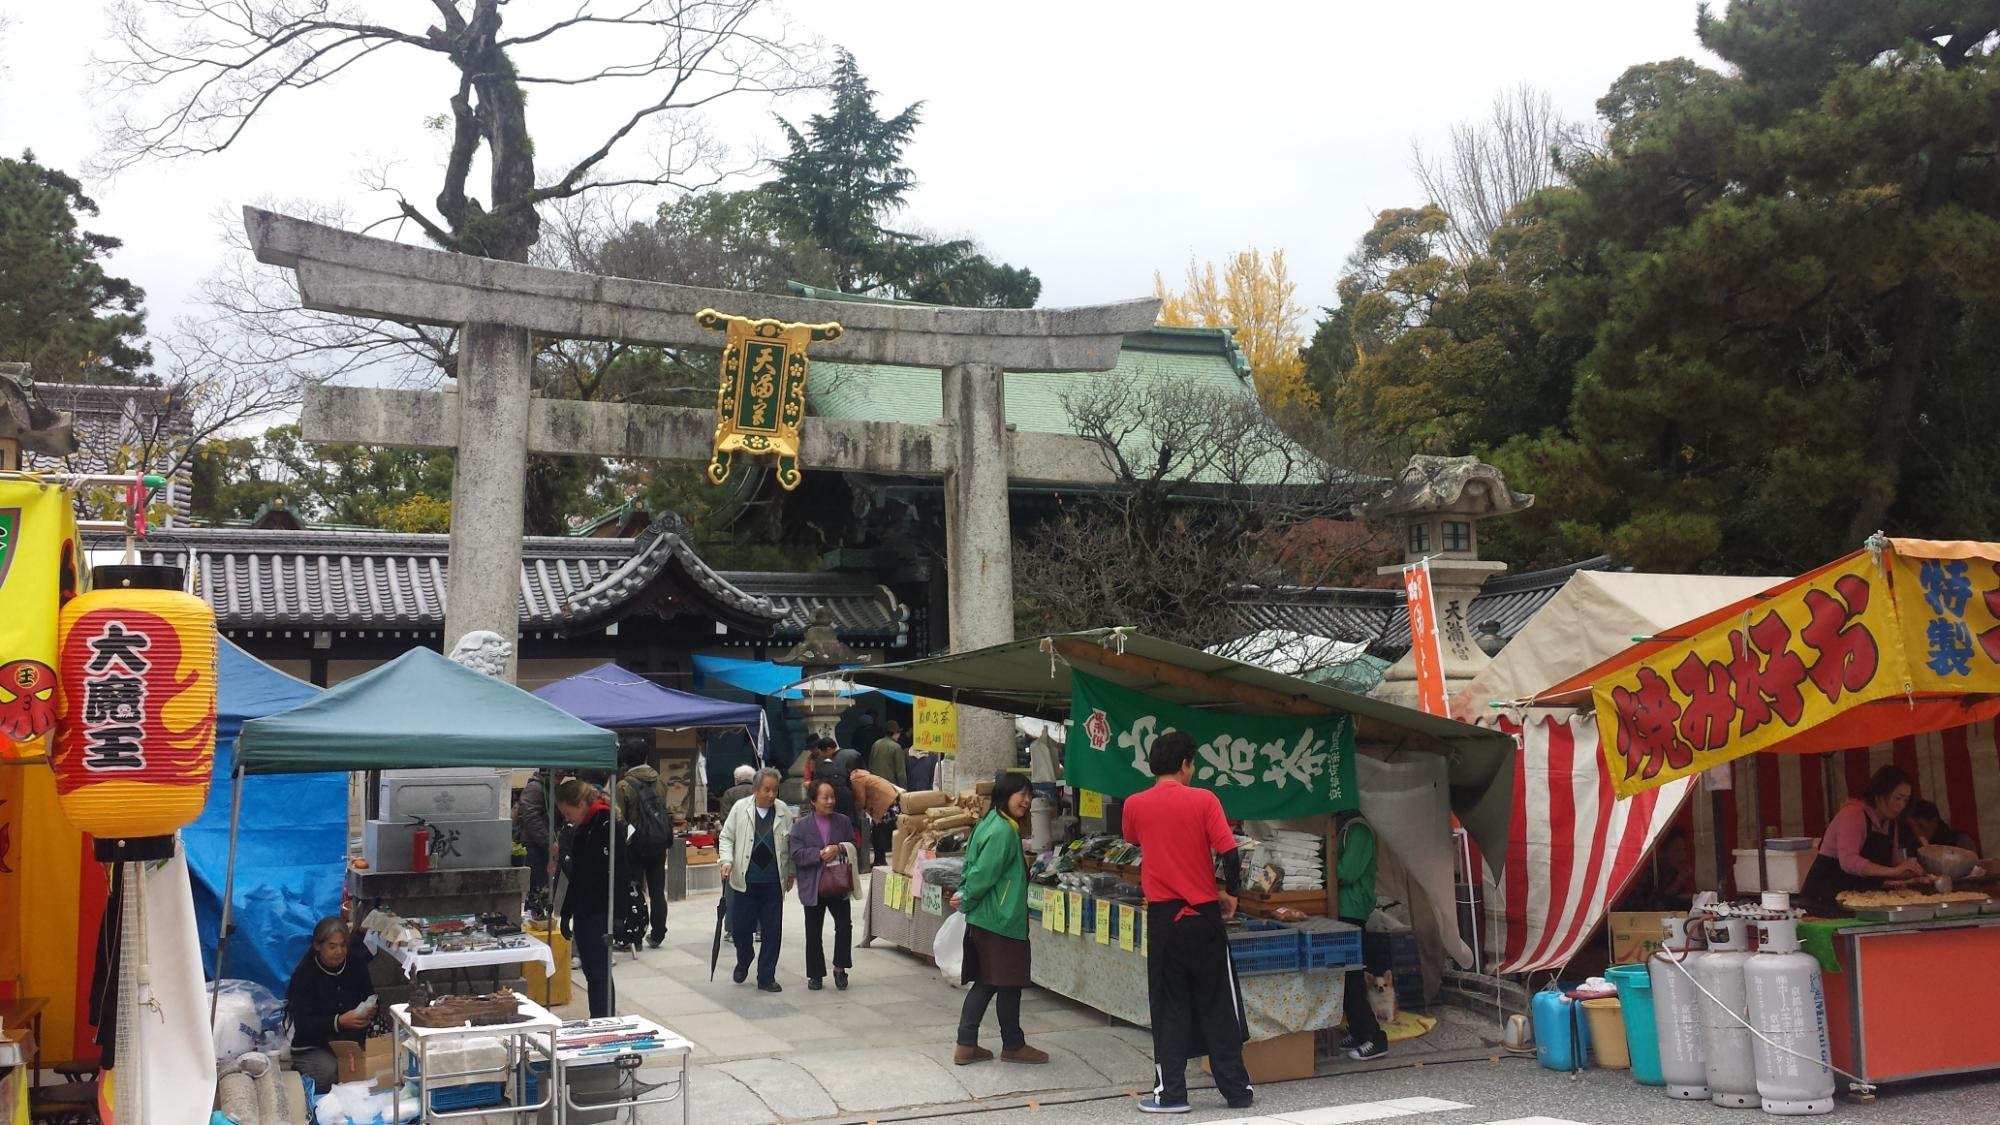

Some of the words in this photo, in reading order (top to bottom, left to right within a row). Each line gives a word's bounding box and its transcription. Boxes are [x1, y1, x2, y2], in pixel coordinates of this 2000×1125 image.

[1918, 558, 1974, 677] 特製
[84, 622, 150, 770] 大魔王
